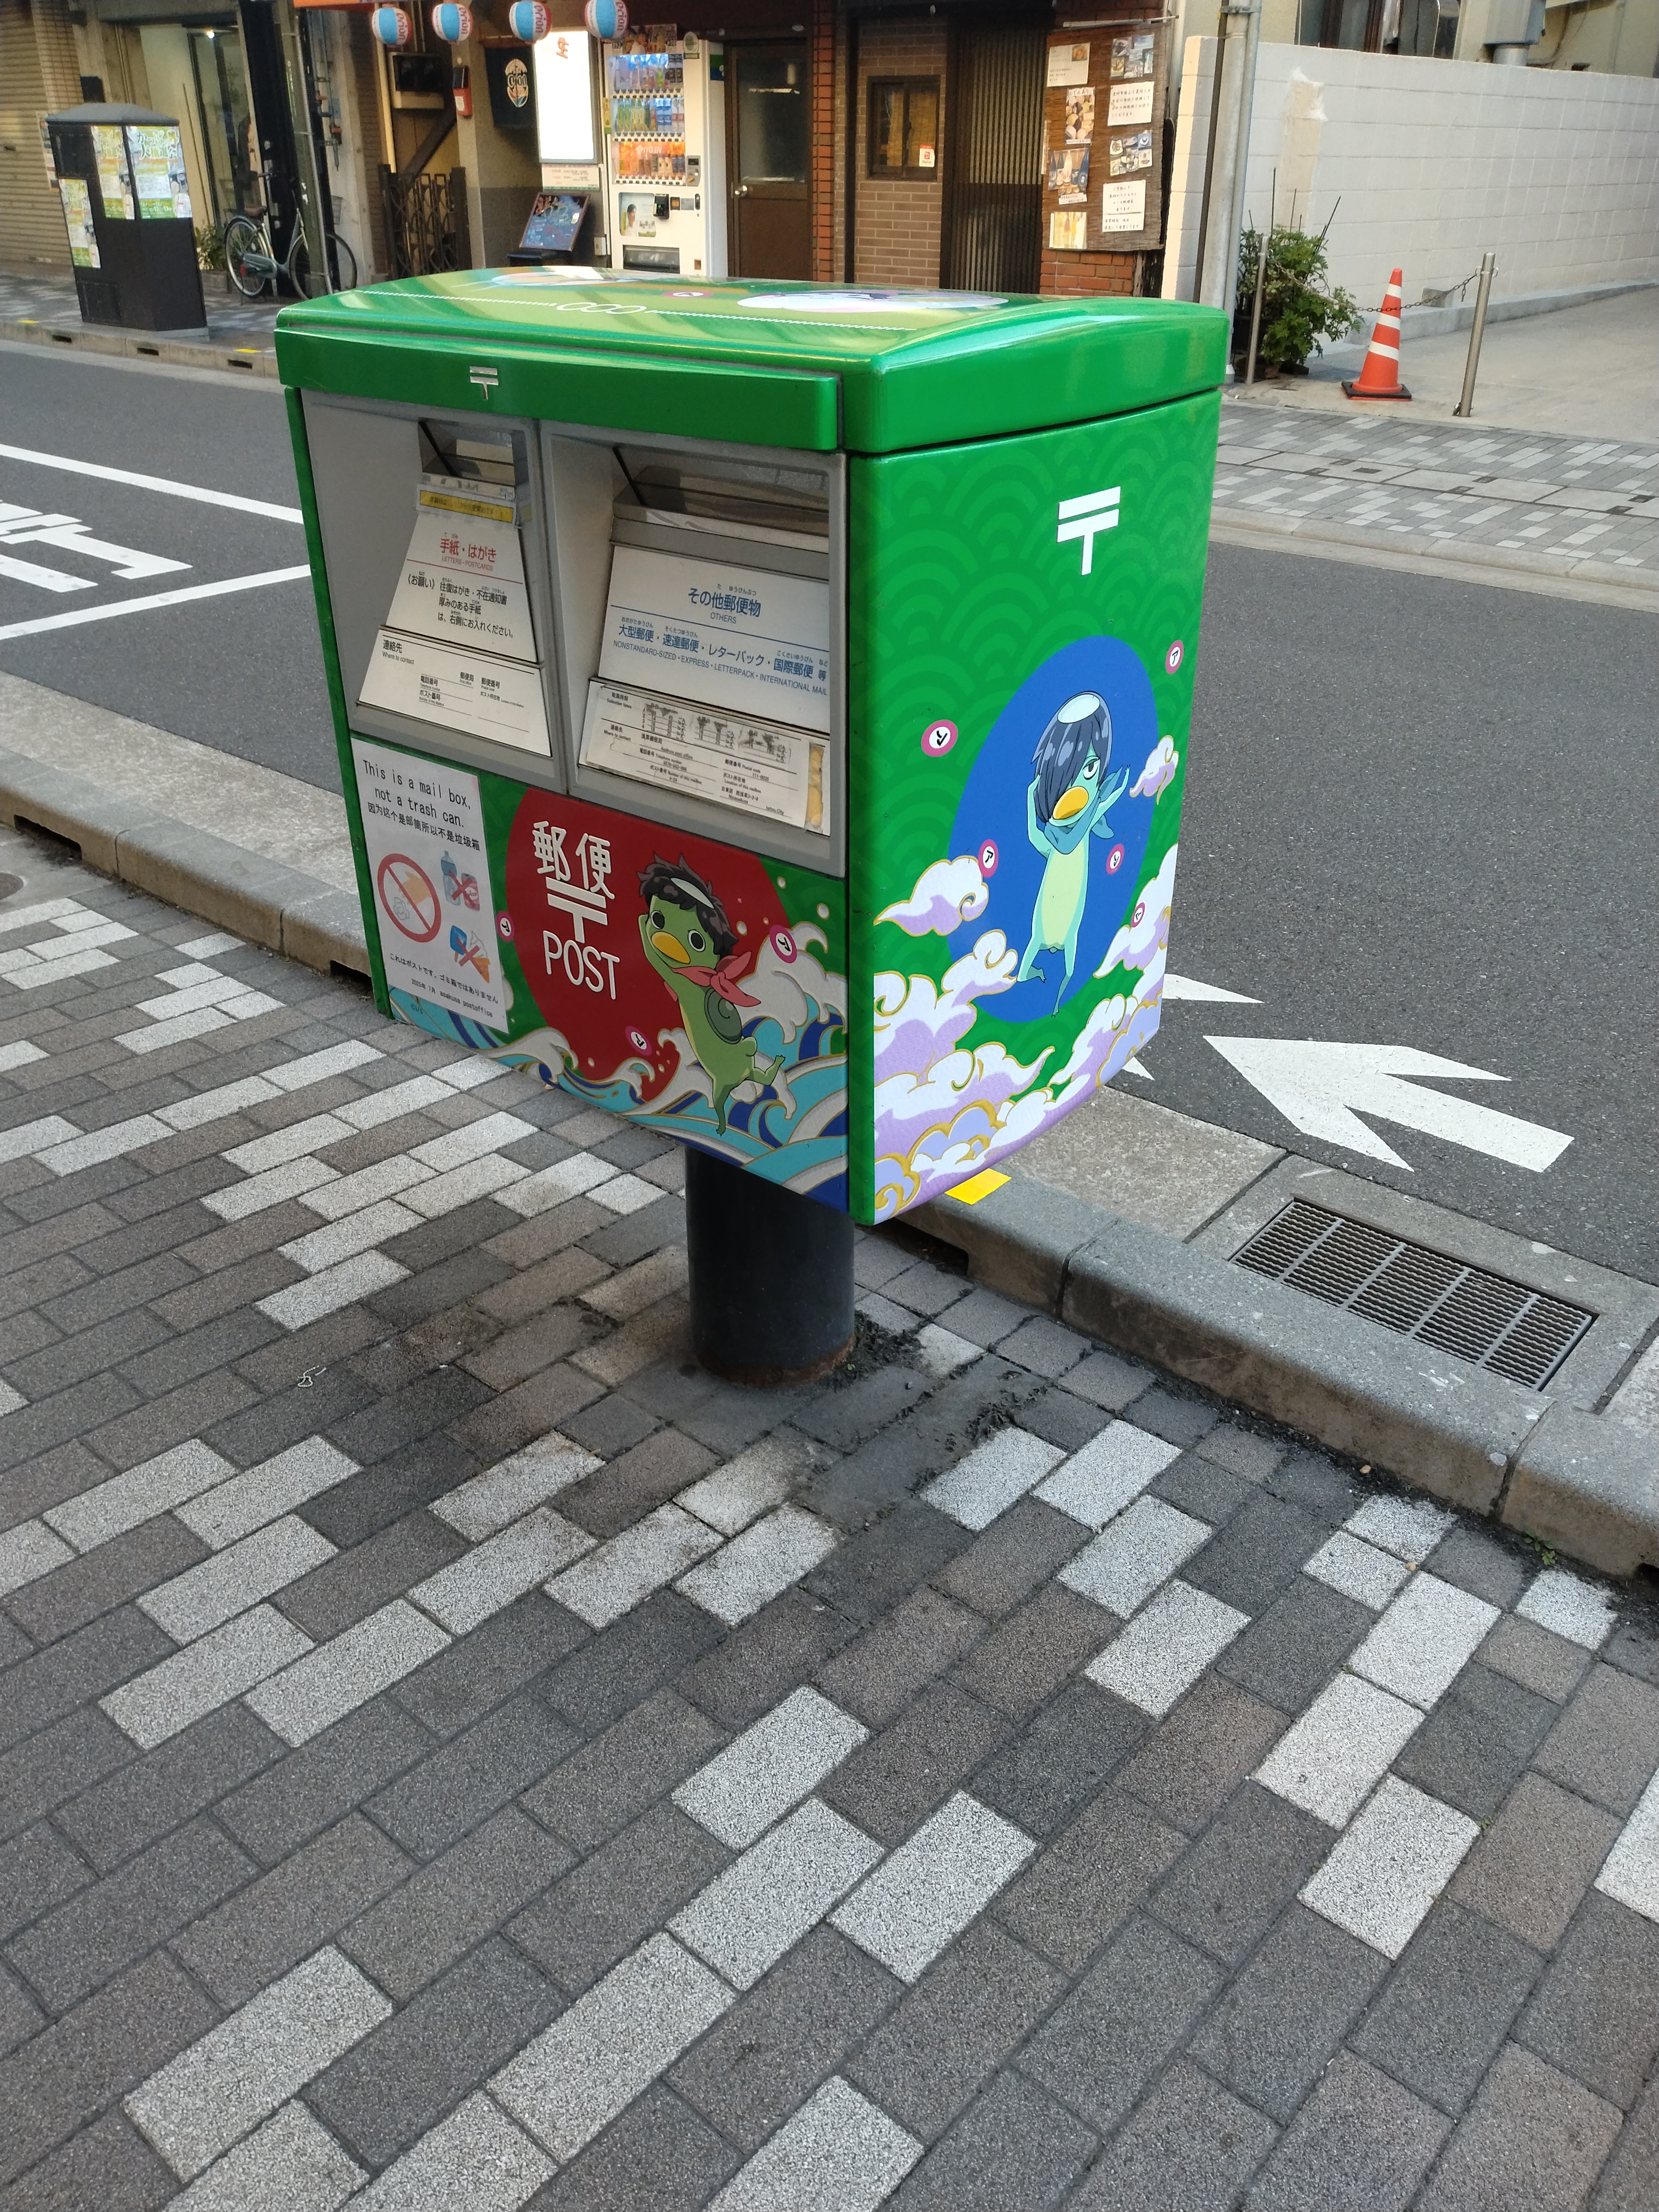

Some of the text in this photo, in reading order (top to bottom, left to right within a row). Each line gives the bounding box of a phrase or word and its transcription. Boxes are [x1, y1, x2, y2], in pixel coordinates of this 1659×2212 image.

[440, 538, 497, 563] 手紙・はがき
[439, 597, 481, 615] 厚みのある手紙
[688, 588, 761, 617] その他郵便物
[438, 611, 513, 638] は、右側にお入れください。
[710, 612, 736, 624] OTHERS
[382, 651, 395, 659] Where
[383, 639, 403, 653] 連絡先
[759, 673, 810, 692] INTERNATIONAL
[812, 685, 827, 696] MAIL
[818, 668, 827, 681] 等
[363, 759, 471, 810] This is a mail box,
[375, 787, 464, 828] not a trash can.
[367, 802, 480, 851] 因为这个是邮筒所以不是垃圾箱
[532, 820, 615, 900] 郵便
[543, 929, 621, 1000] POST
